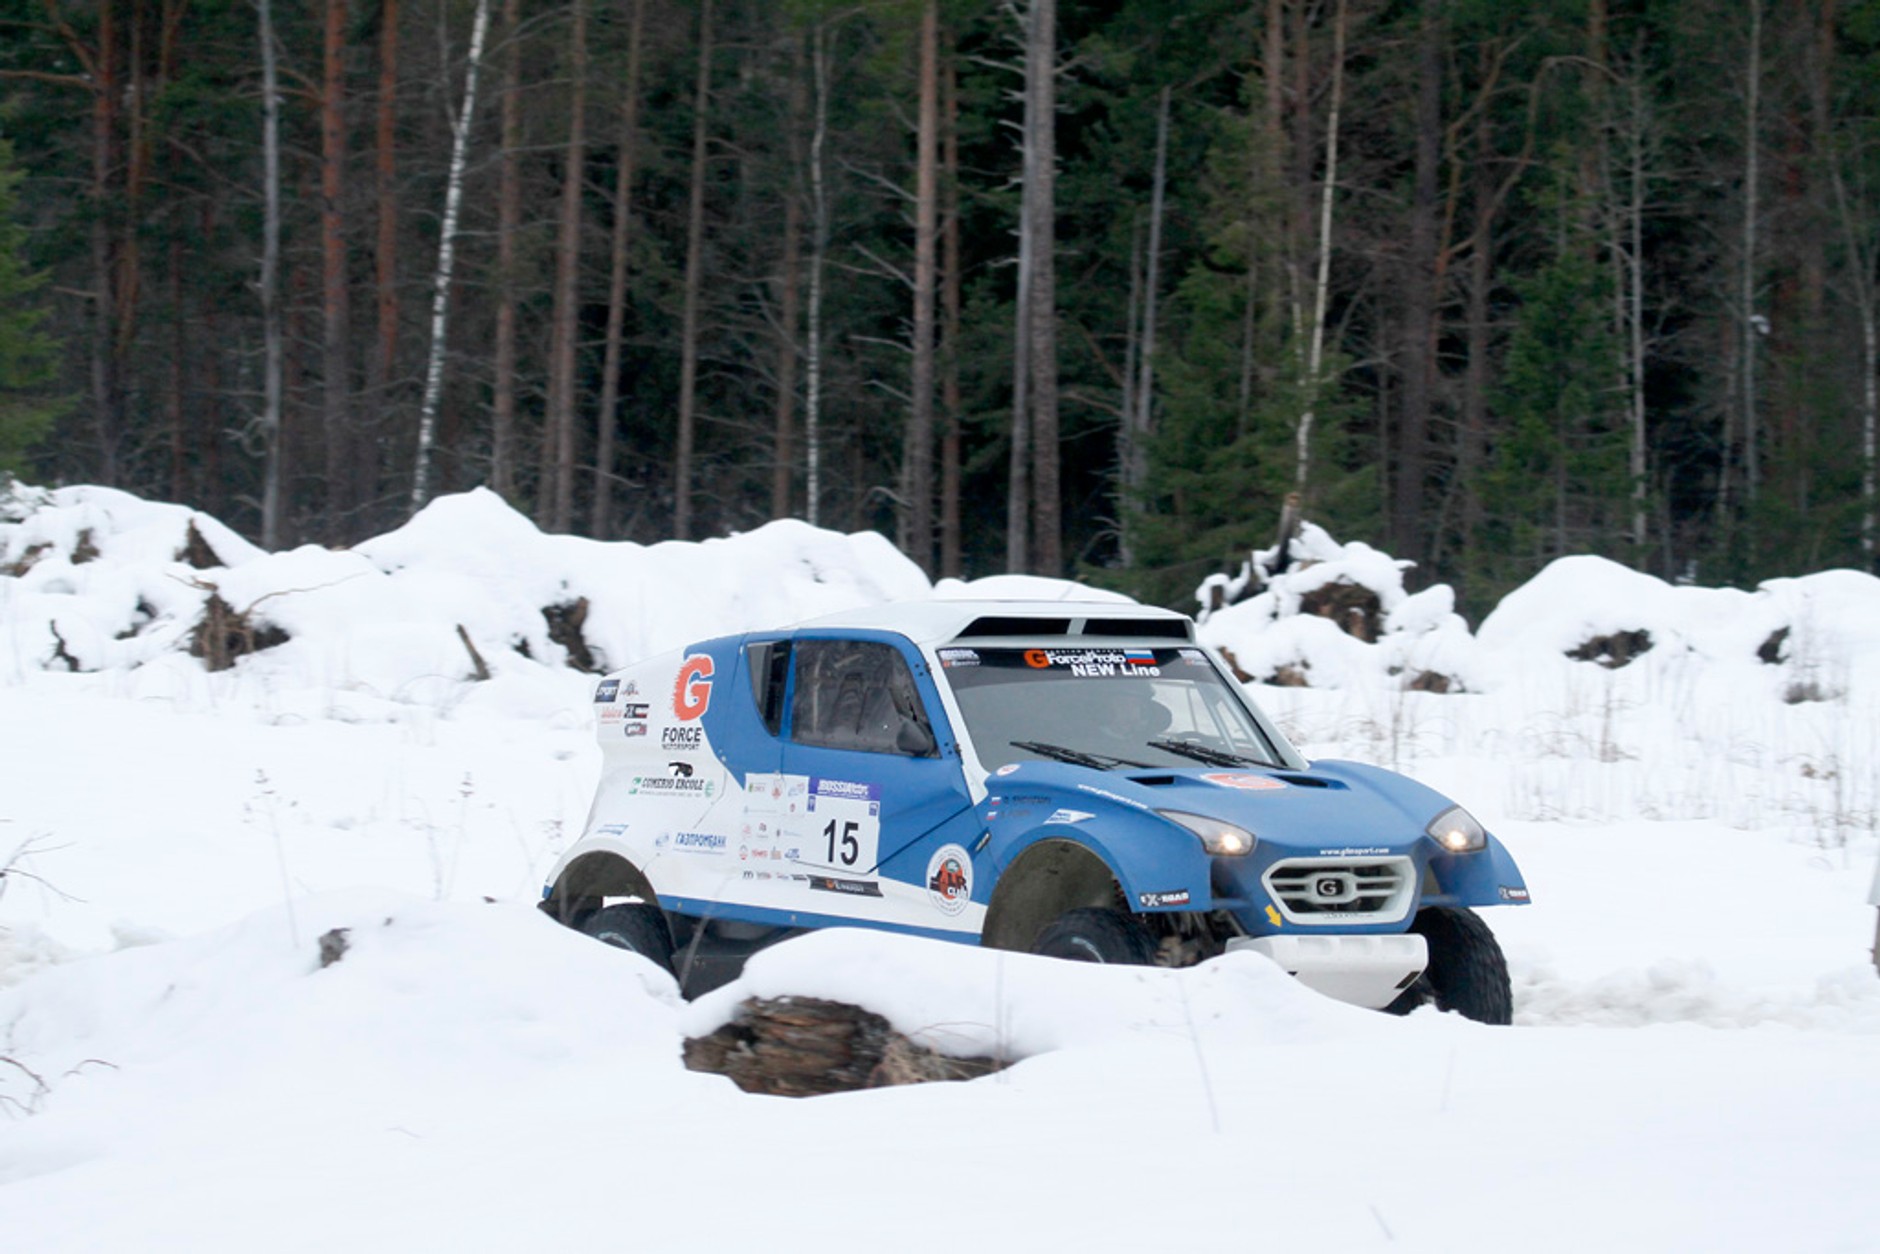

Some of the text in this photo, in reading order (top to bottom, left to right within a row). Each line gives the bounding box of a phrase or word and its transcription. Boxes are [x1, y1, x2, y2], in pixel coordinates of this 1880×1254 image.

[1071, 663, 1161, 677] NEW Line
[672, 655, 713, 721] G
[662, 727, 702, 742] FORCE
[675, 778, 704, 790] ERCOLE
[823, 818, 859, 866] 15
[1319, 880, 1338, 896] G
